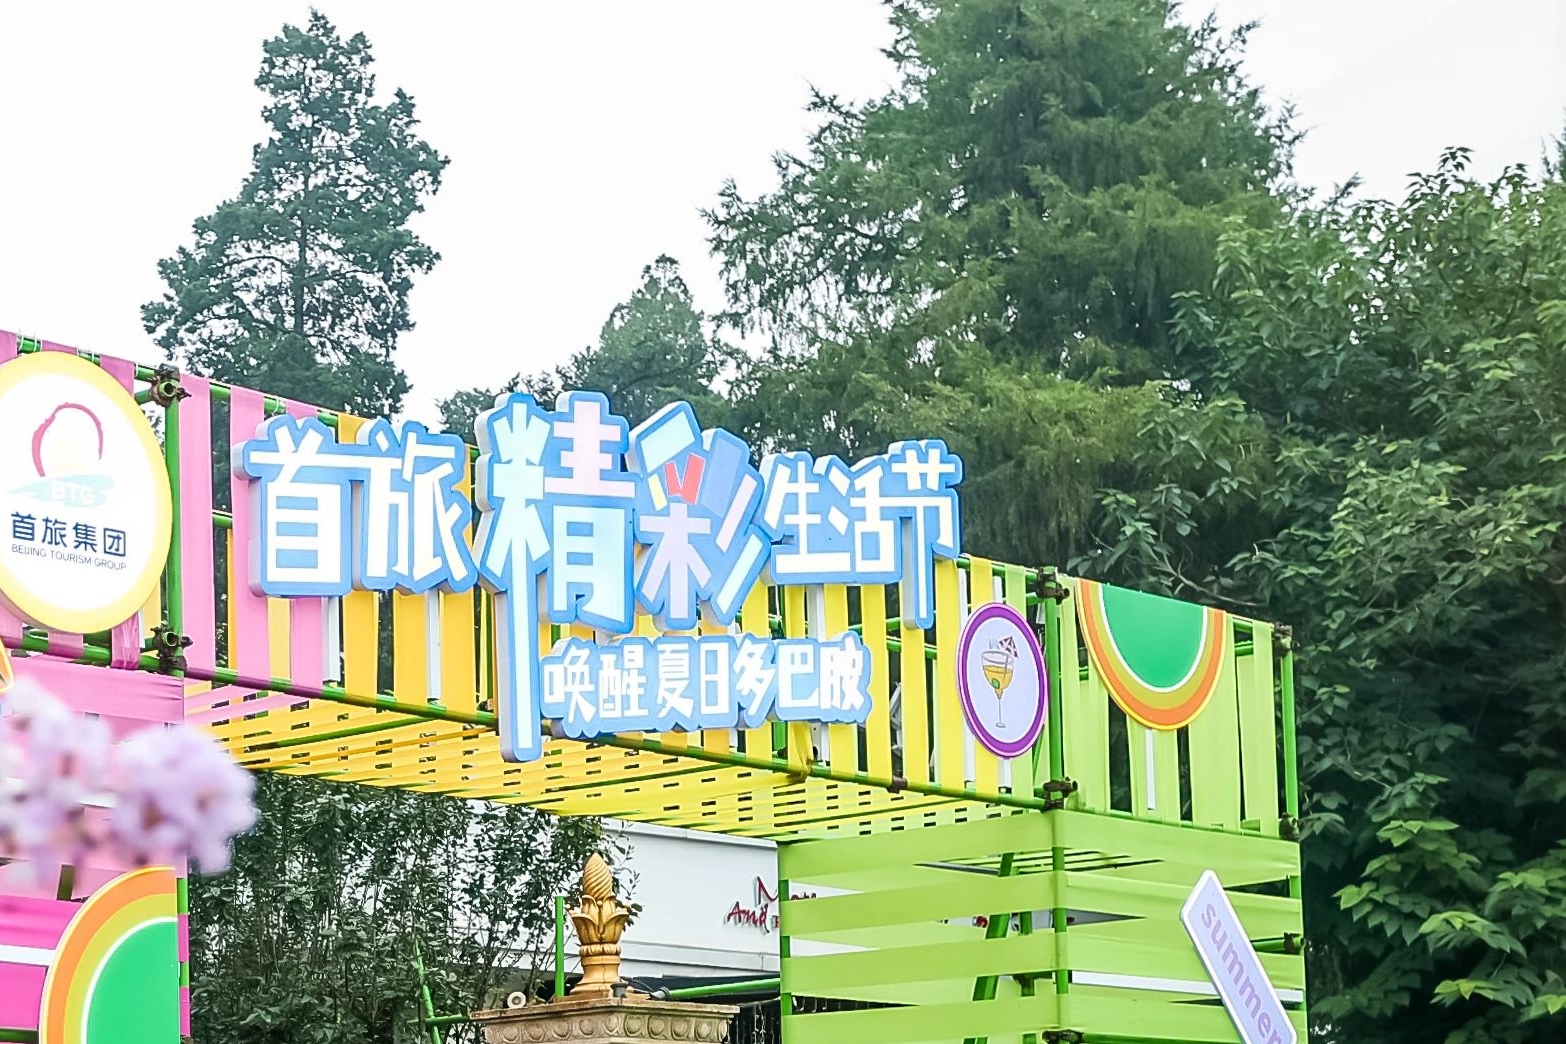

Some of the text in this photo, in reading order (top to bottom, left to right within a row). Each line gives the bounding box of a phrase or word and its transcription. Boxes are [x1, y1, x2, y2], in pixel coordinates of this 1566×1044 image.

[50, 480, 96, 504] BTG
[10, 511, 126, 557] 首旅集团
[11, 543, 127, 571] BEIJING TOURISM GROUP
[247, 400, 956, 749] 首旅精彩生活节
[543, 635, 864, 724] 唤醒夏日多巴胺
